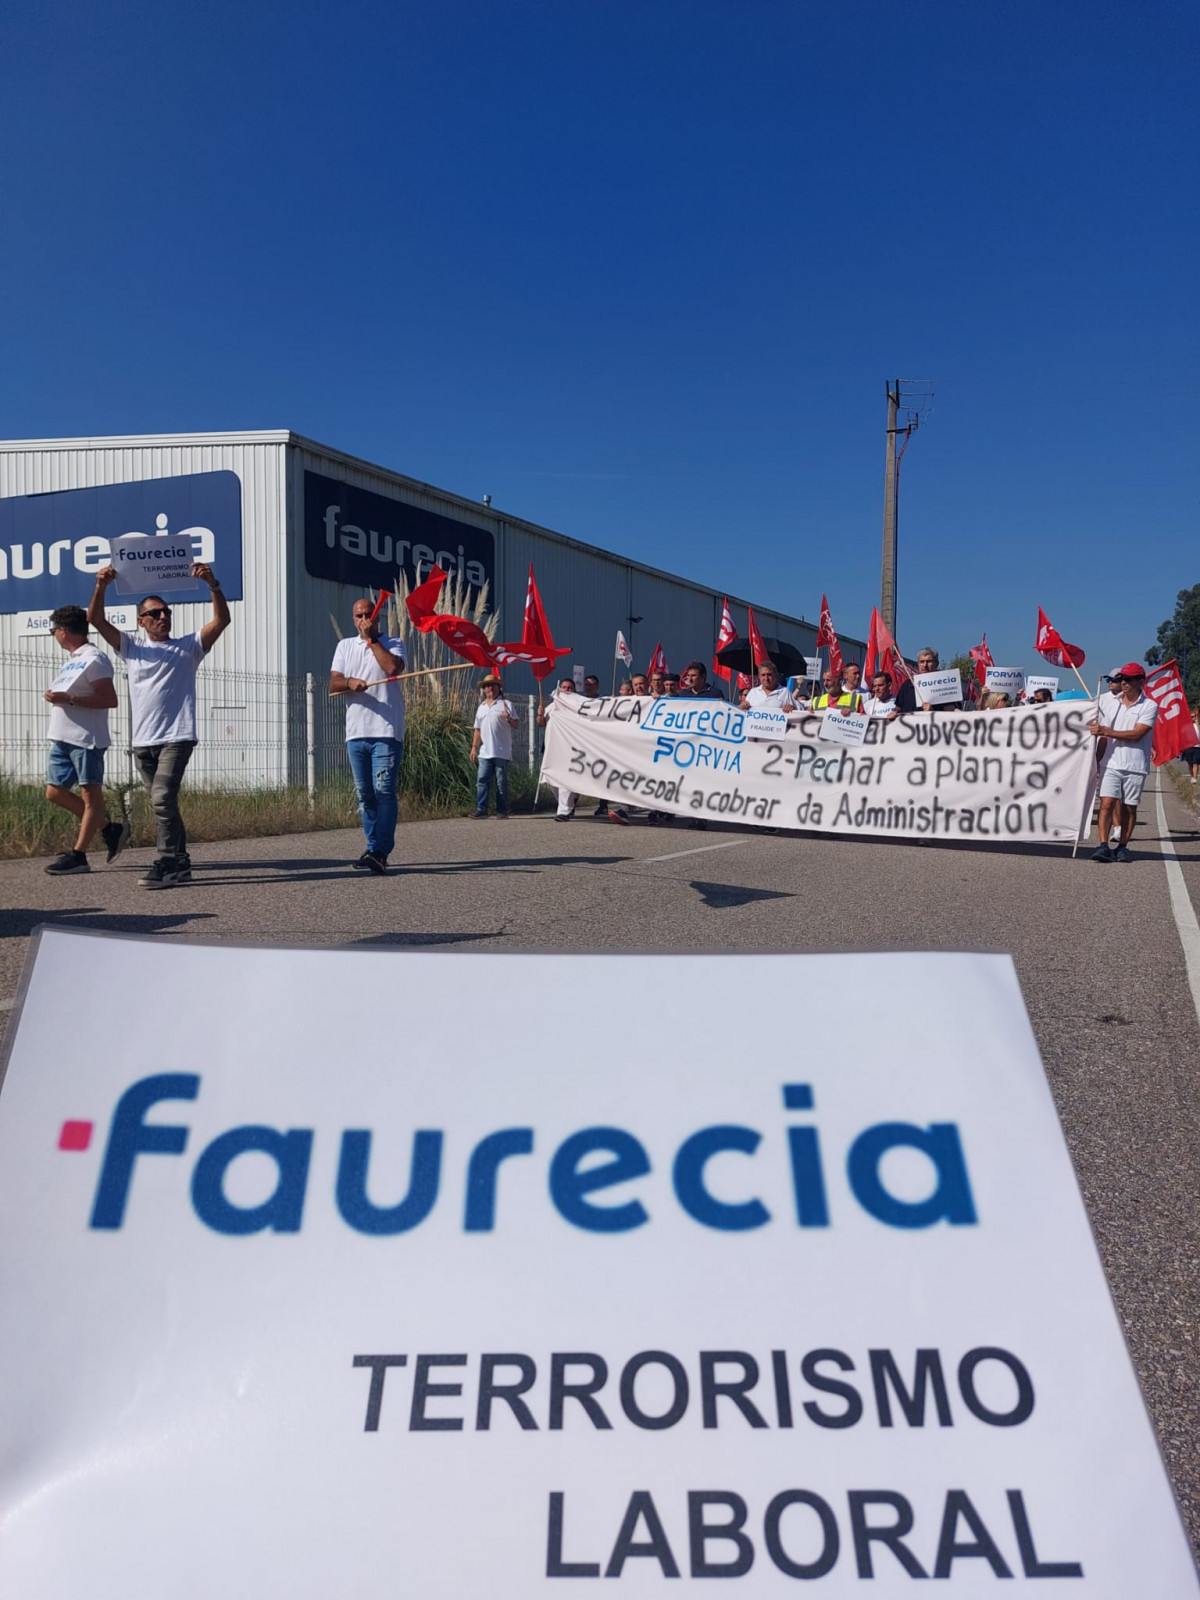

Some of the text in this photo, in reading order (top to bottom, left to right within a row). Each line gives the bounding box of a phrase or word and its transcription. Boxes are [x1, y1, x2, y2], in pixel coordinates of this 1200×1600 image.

[119, 546, 186, 561] faurecia
[143, 563, 189, 572] TERRORISMO
[158, 571, 190, 580] LABORAL
[917, 676, 957, 687] faurecia
[578, 698, 641, 724] ETICA
[746, 711, 786, 723] FORVIA
[750, 724, 774, 732] FRAUDE
[827, 713, 864, 729] faurecia
[654, 736, 741, 774] FORVIA
[797, 791, 824, 827] da
[89, 1071, 980, 1235] faurecia
[352, 1346, 1037, 1432] TERRORISMO
[545, 1489, 1084, 1580] LABORAL
